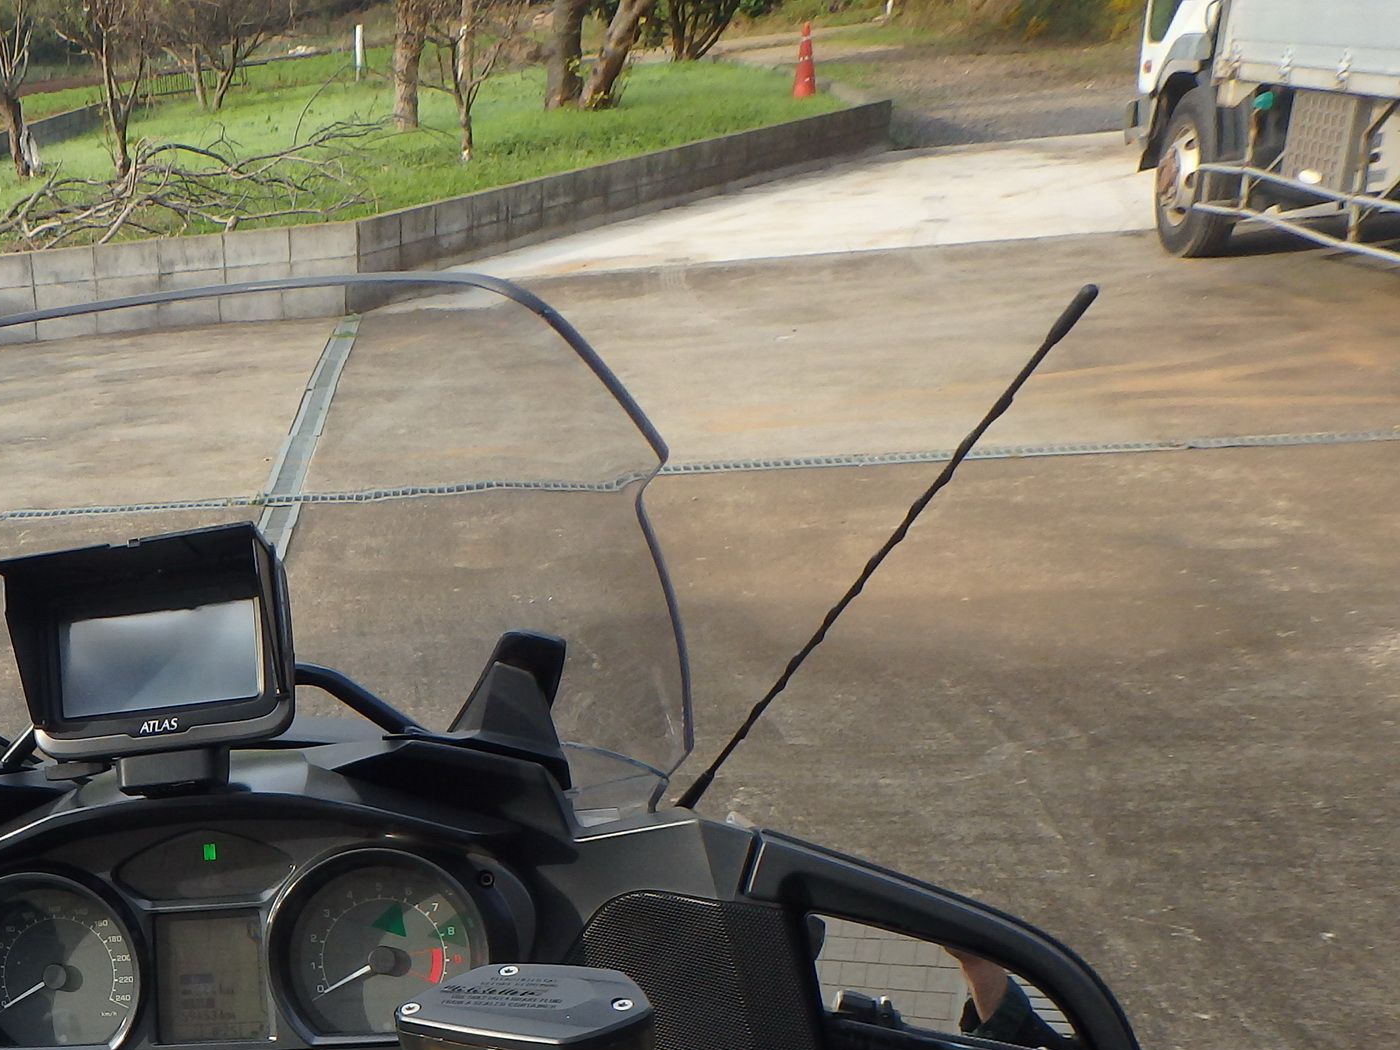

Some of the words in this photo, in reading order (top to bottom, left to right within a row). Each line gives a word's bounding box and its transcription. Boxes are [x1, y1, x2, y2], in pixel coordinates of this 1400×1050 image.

[139, 717, 178, 734] ATLAS
[431, 903, 439, 911] 7
[447, 927, 455, 935] 8
